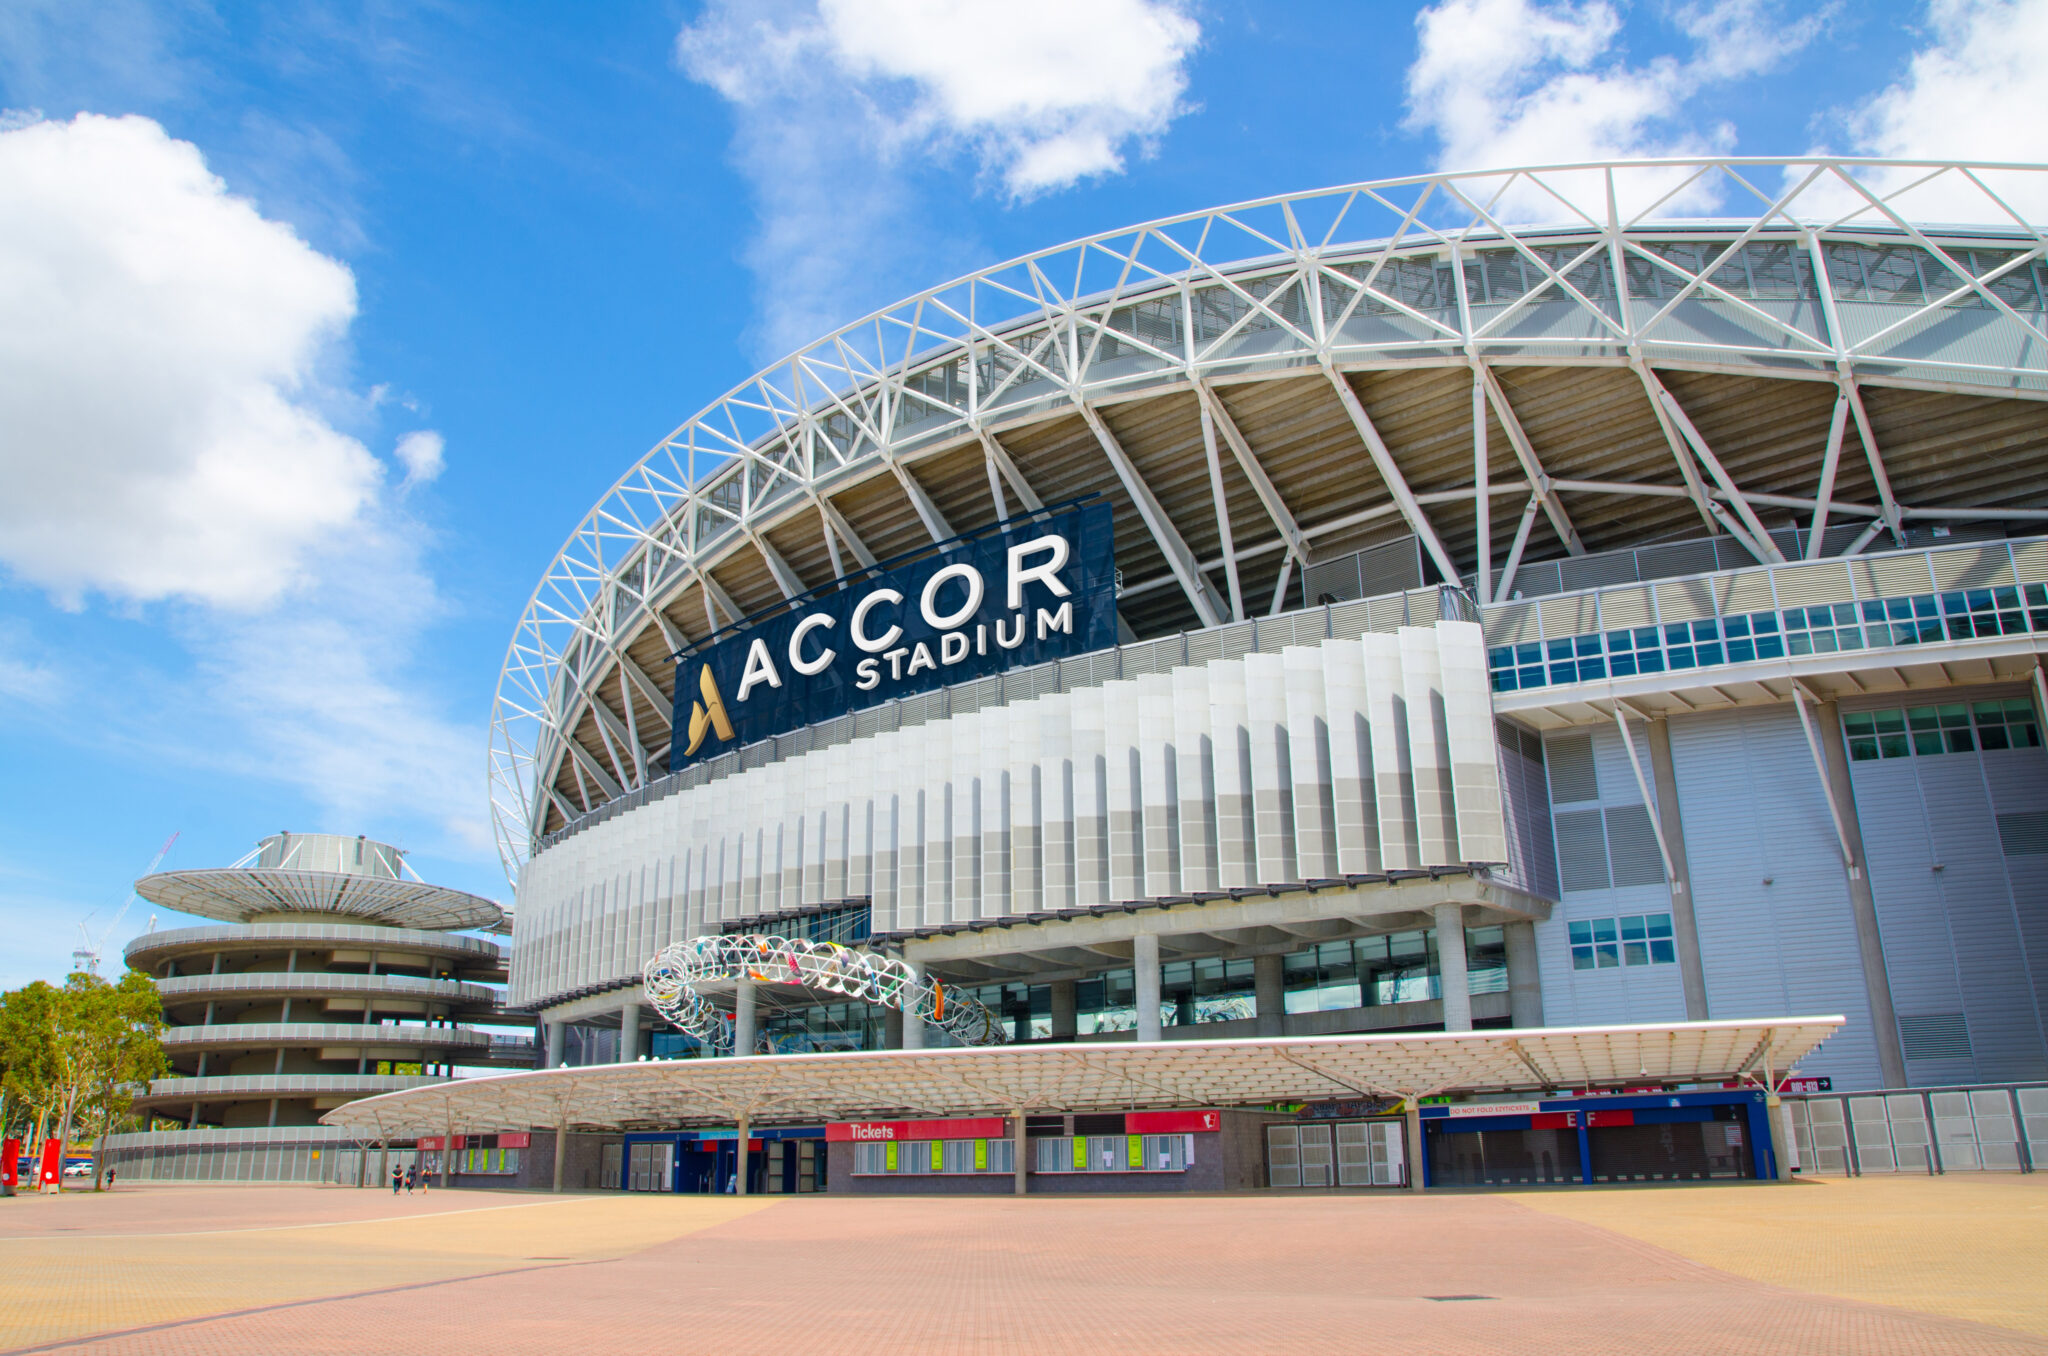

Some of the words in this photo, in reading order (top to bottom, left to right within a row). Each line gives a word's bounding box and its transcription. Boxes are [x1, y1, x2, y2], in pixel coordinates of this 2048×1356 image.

[736, 534, 1072, 702] ACCOR
[855, 601, 1073, 691] STADIUM
[1567, 1113, 1577, 1127] E
[1586, 1112, 1596, 1126] F
[850, 1123, 894, 1139] Tickets
